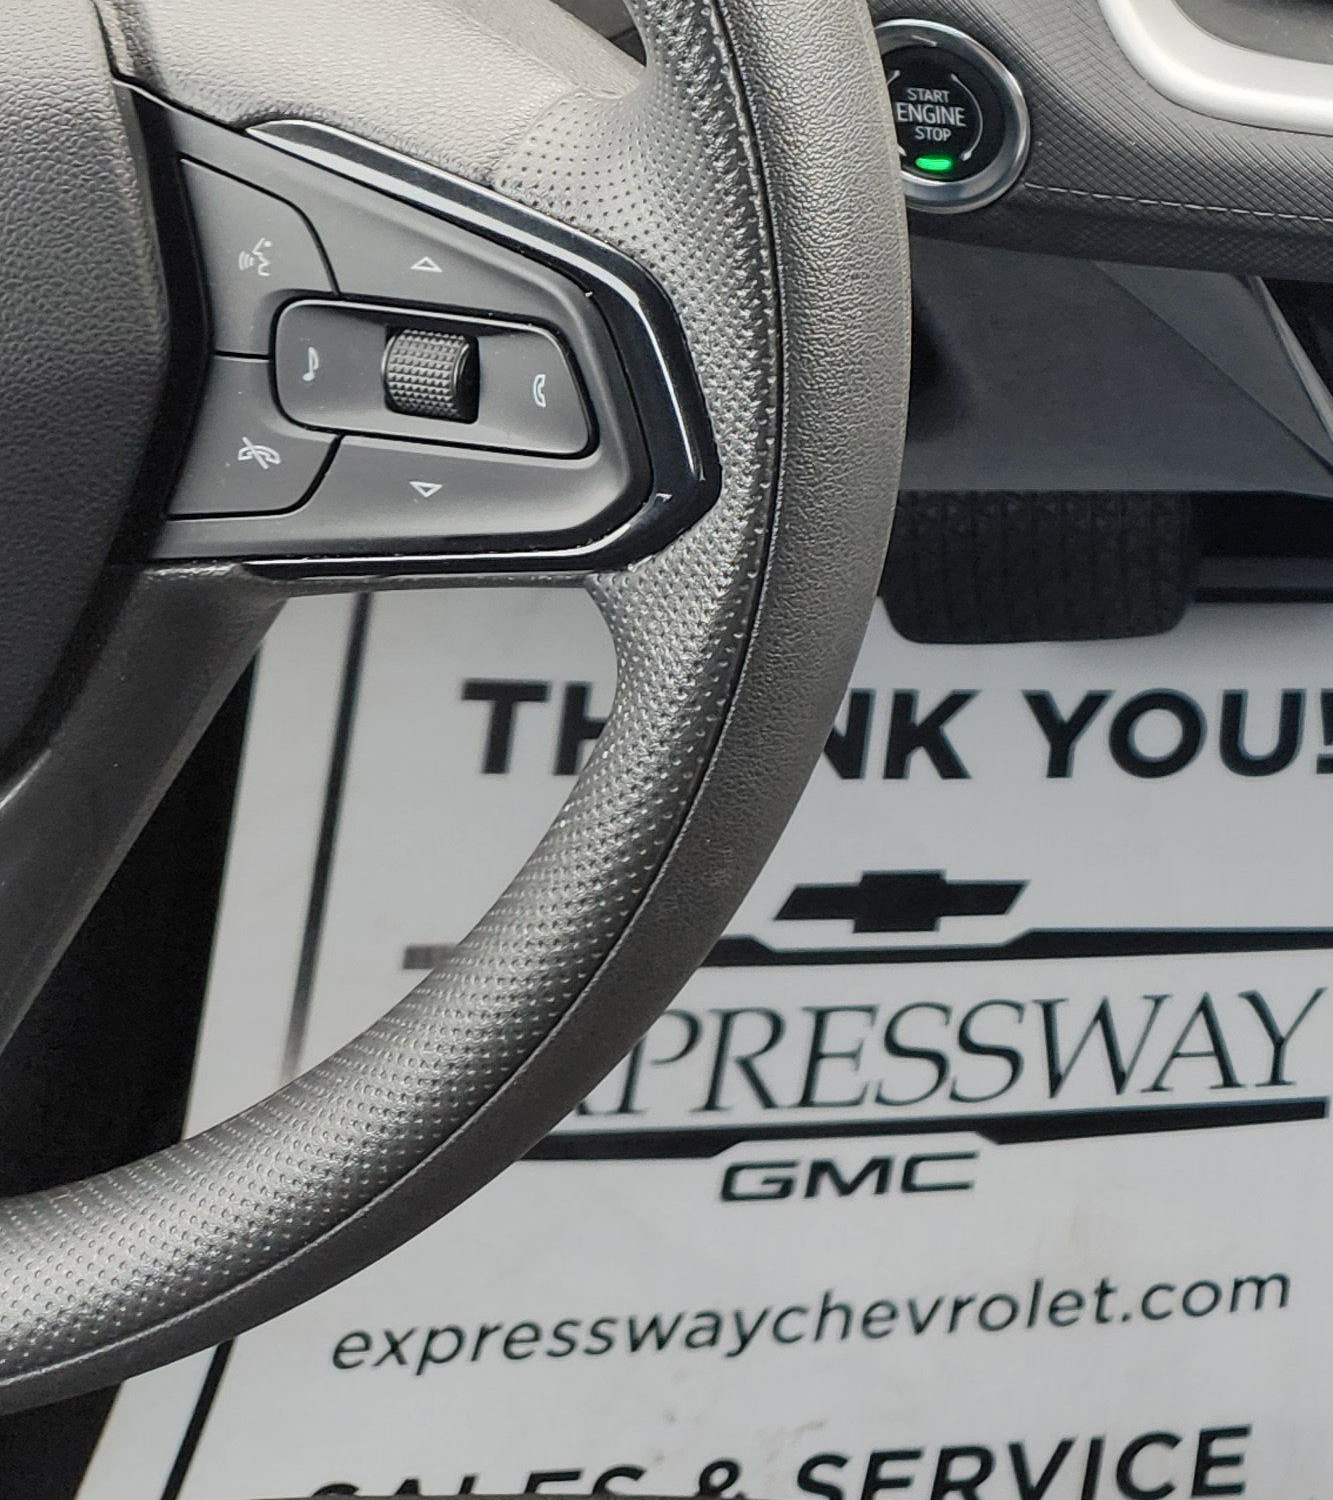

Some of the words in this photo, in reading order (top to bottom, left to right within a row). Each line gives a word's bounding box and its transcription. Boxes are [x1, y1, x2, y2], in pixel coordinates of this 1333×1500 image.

[895, 102, 967, 127] ENGINE
[906, 87, 951, 103] START
[914, 126, 952, 142] STOP
[463, 679, 981, 783] THNK
[577, 986, 1328, 1116] PRESSWAY
[720, 1150, 980, 1203] GMC
[332, 1266, 1291, 1376] expresswaychevrolet.com
[796, 1424, 1253, 1500] SERVICE
